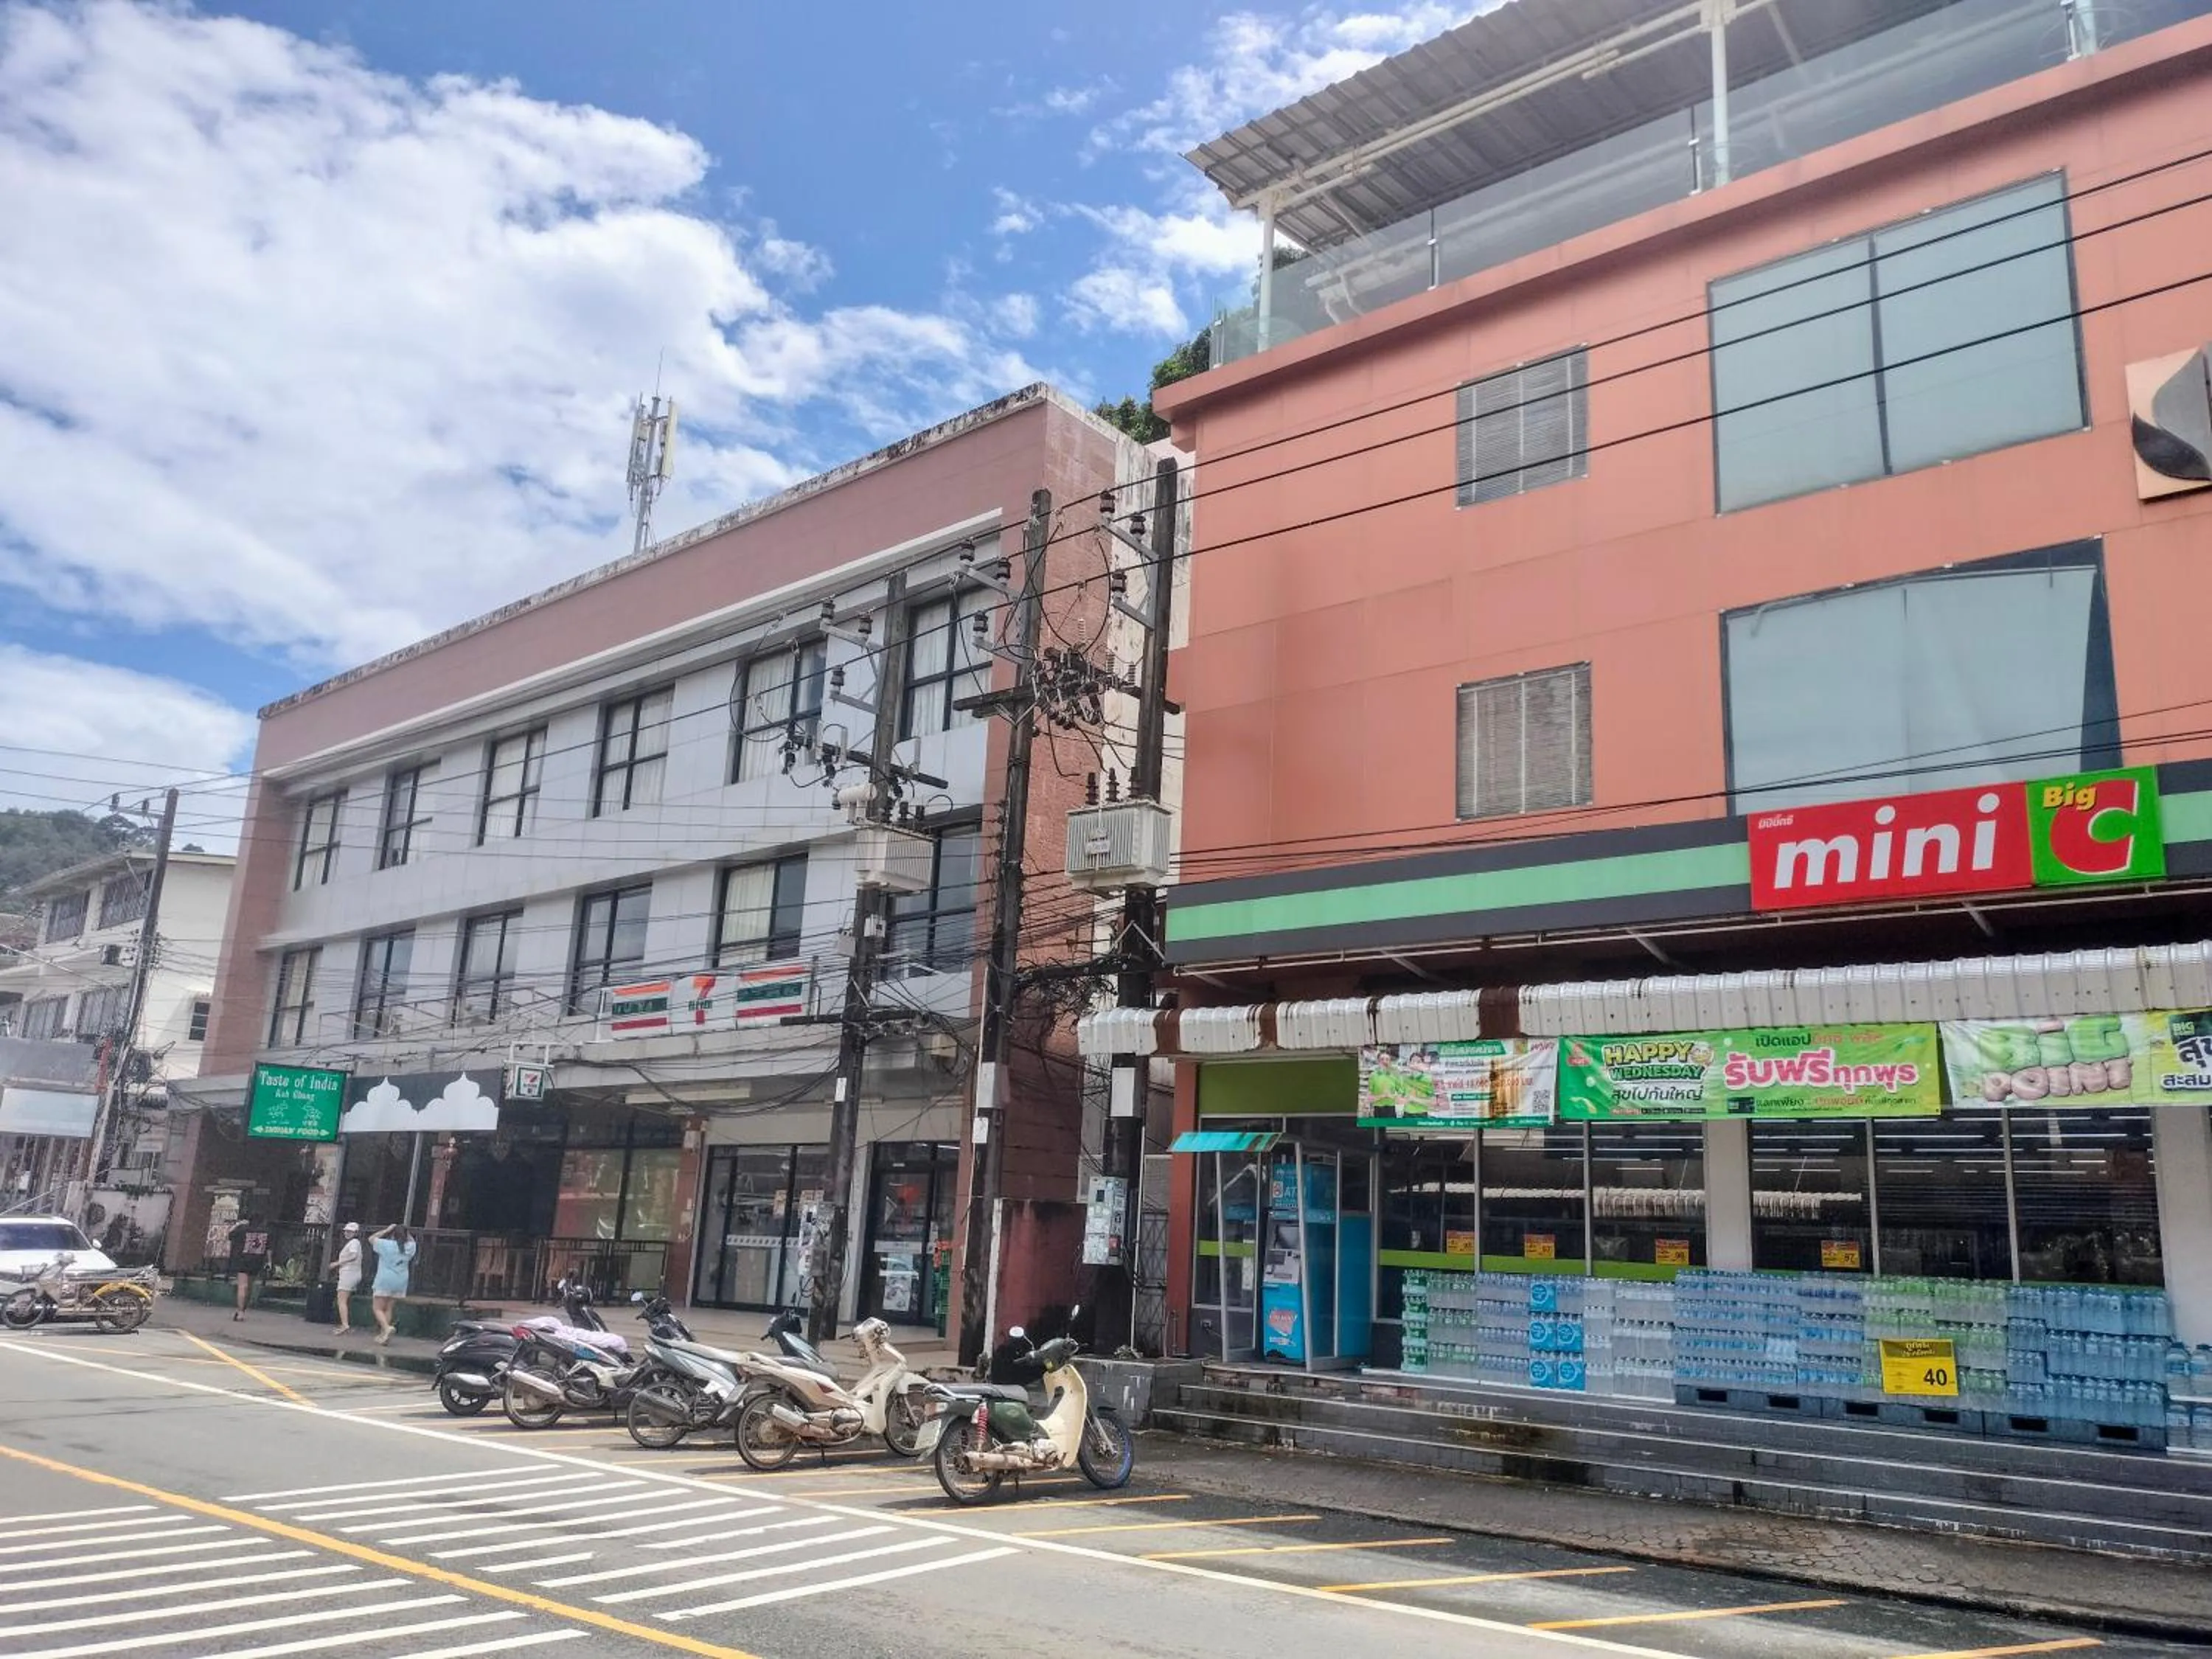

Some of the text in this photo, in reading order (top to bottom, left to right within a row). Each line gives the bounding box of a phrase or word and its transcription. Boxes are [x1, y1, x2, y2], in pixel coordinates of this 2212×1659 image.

[2043, 779, 2138, 874] Big C
[1773, 793, 2000, 889] mini
[1604, 1041, 1694, 1066] HAPPY
[260, 1071, 338, 1091] Taste of India
[1610, 1065, 1705, 1080] WEDNESDAY
[1924, 1368, 1947, 1385] 40
